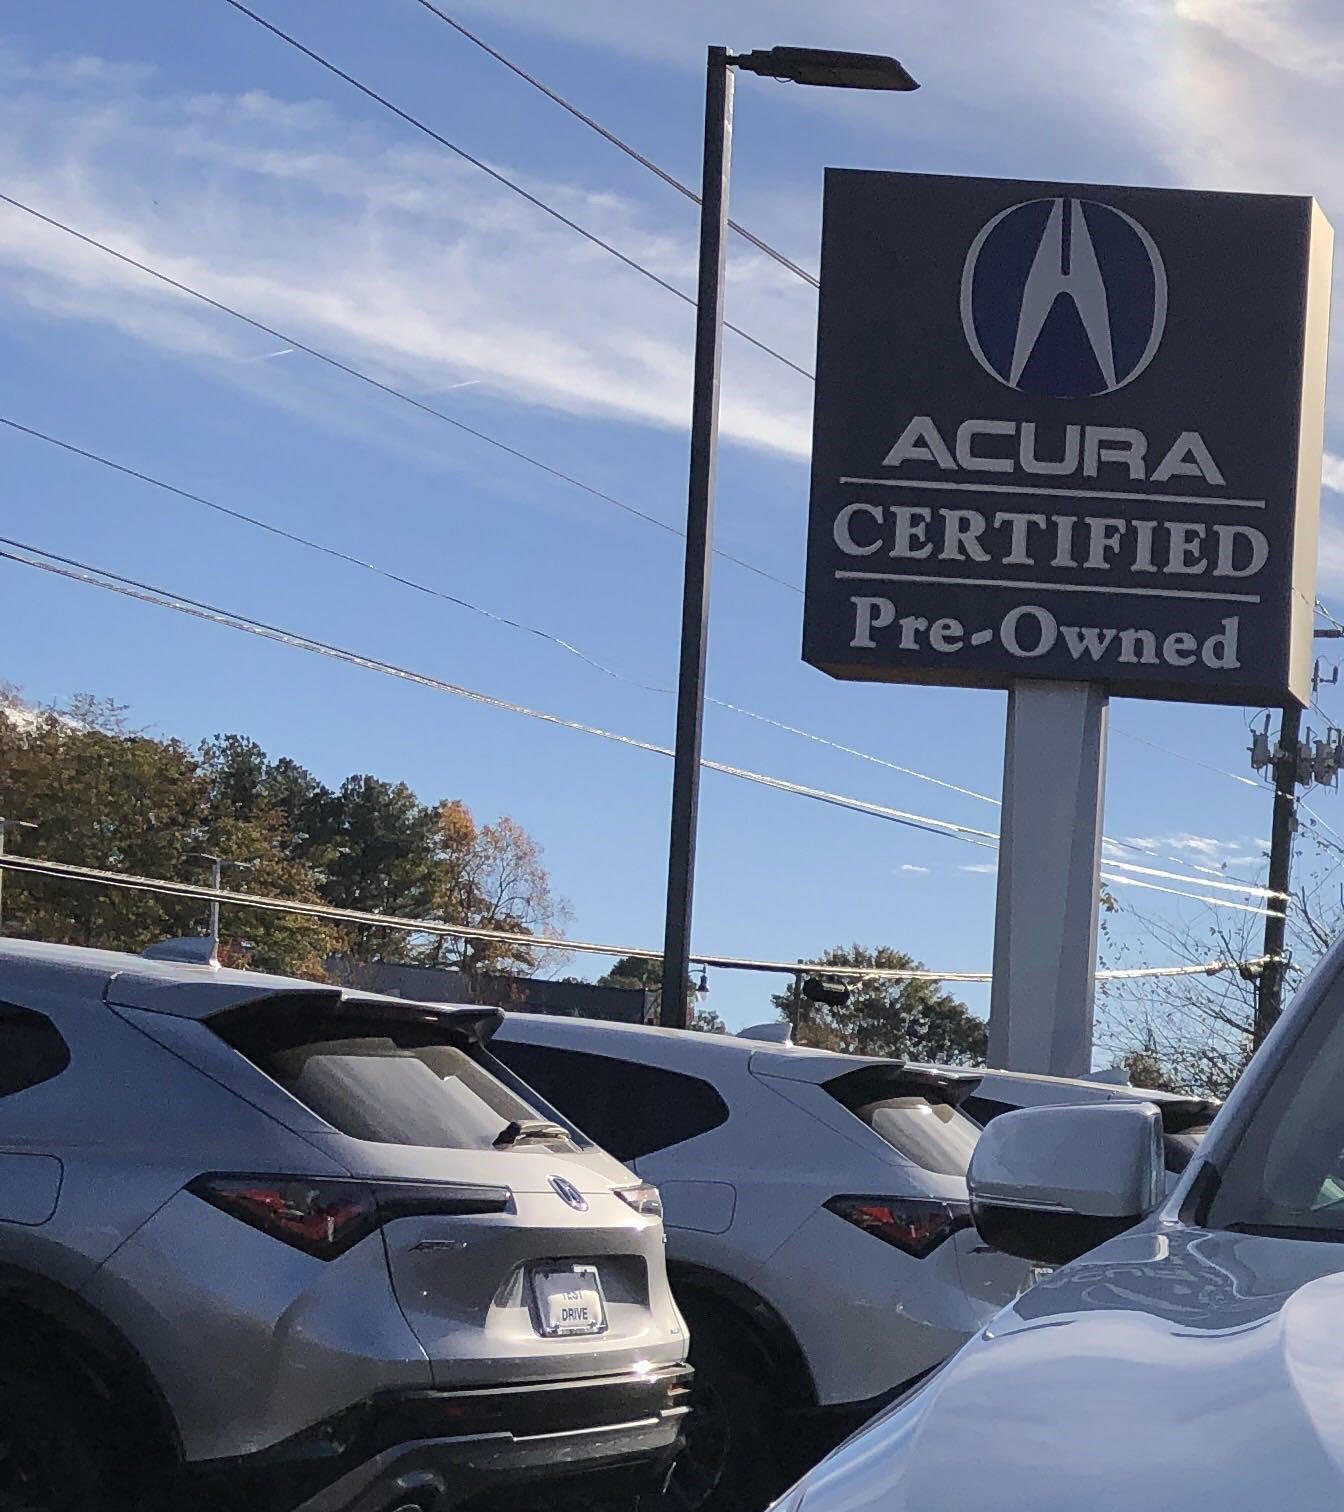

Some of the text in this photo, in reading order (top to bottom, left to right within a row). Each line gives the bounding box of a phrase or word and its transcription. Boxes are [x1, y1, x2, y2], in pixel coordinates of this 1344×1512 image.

[882, 416, 1226, 485] ACURA
[833, 502, 1269, 578] CERTIFIED
[849, 596, 1241, 669] Pre-Owned
[561, 1307, 588, 1321] DRIVE
